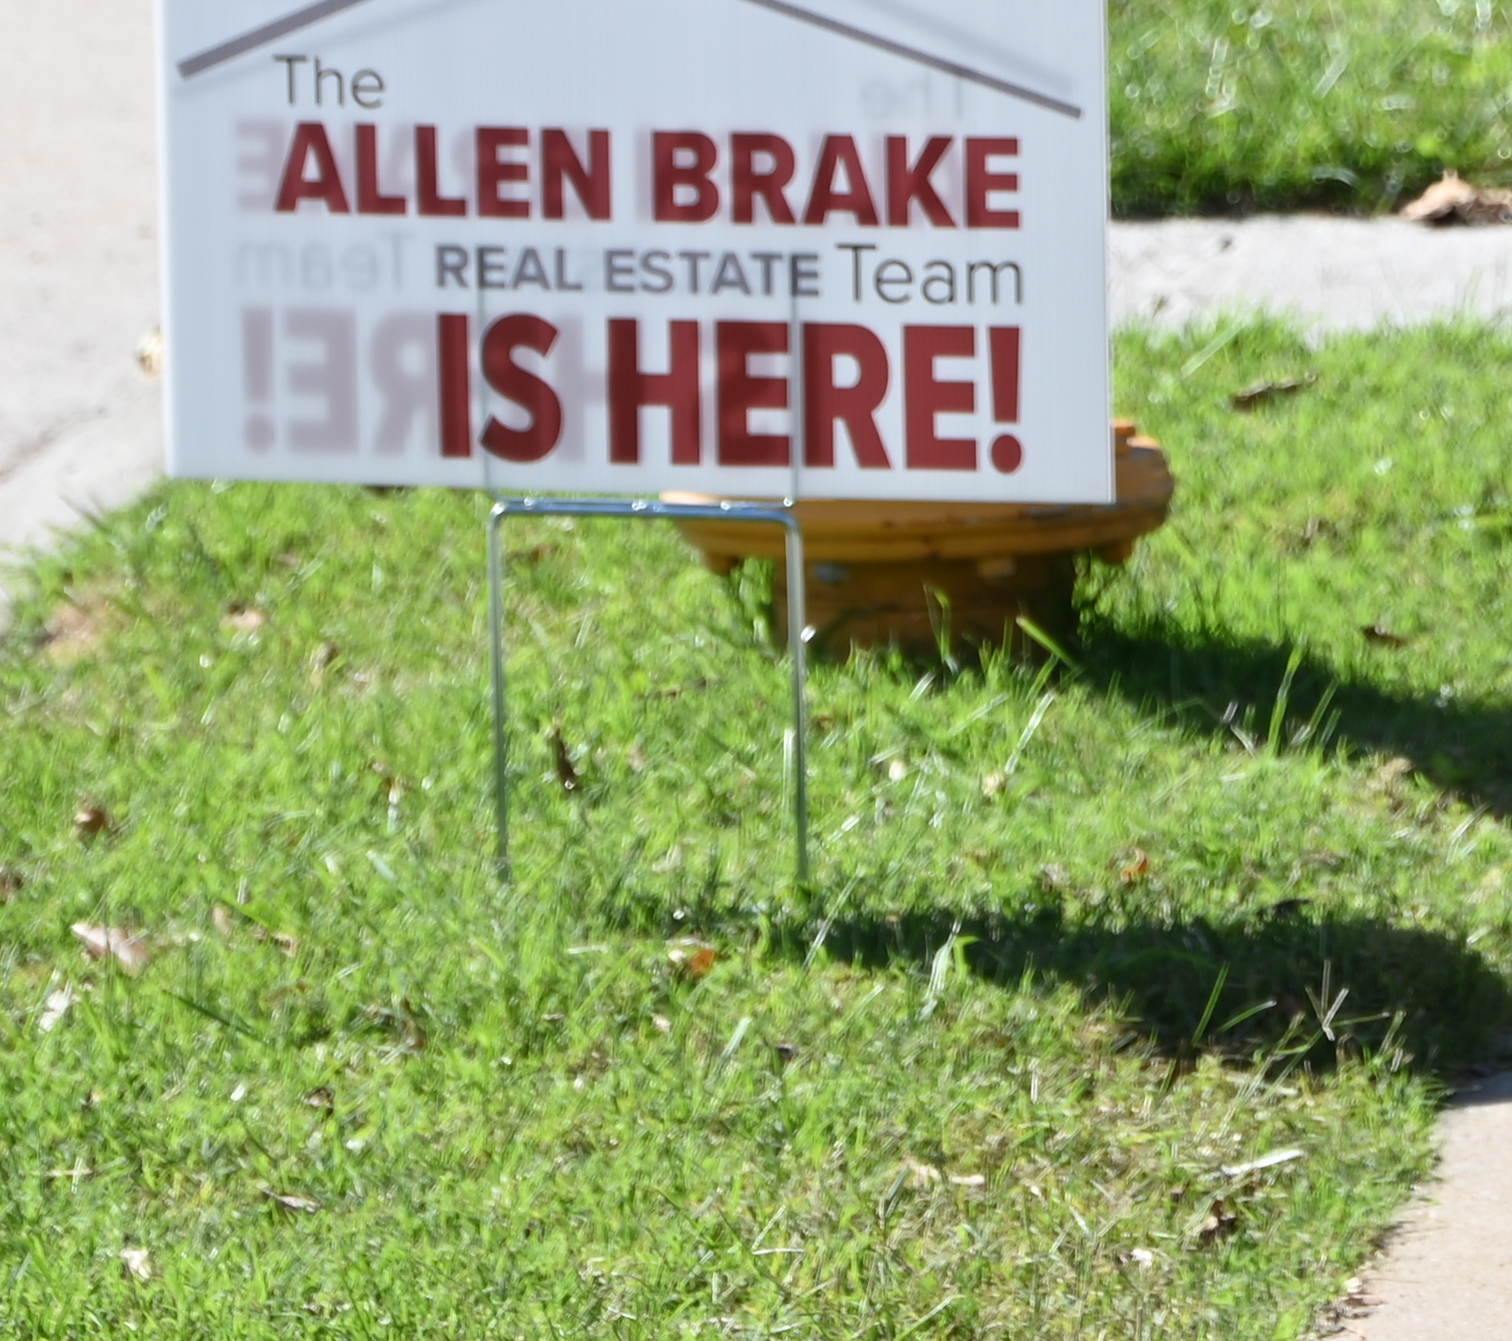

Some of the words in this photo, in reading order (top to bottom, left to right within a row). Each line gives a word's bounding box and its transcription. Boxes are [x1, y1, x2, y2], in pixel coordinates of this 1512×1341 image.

[272, 54, 386, 110] The
[273, 120, 612, 222] ALLEN
[650, 128, 1022, 230] BRAKE
[434, 243, 585, 294] REAL
[604, 247, 821, 299] ESTATE
[836, 243, 1026, 306] Team
[437, 311, 564, 466] IS
[607, 316, 1024, 477] HERE!
